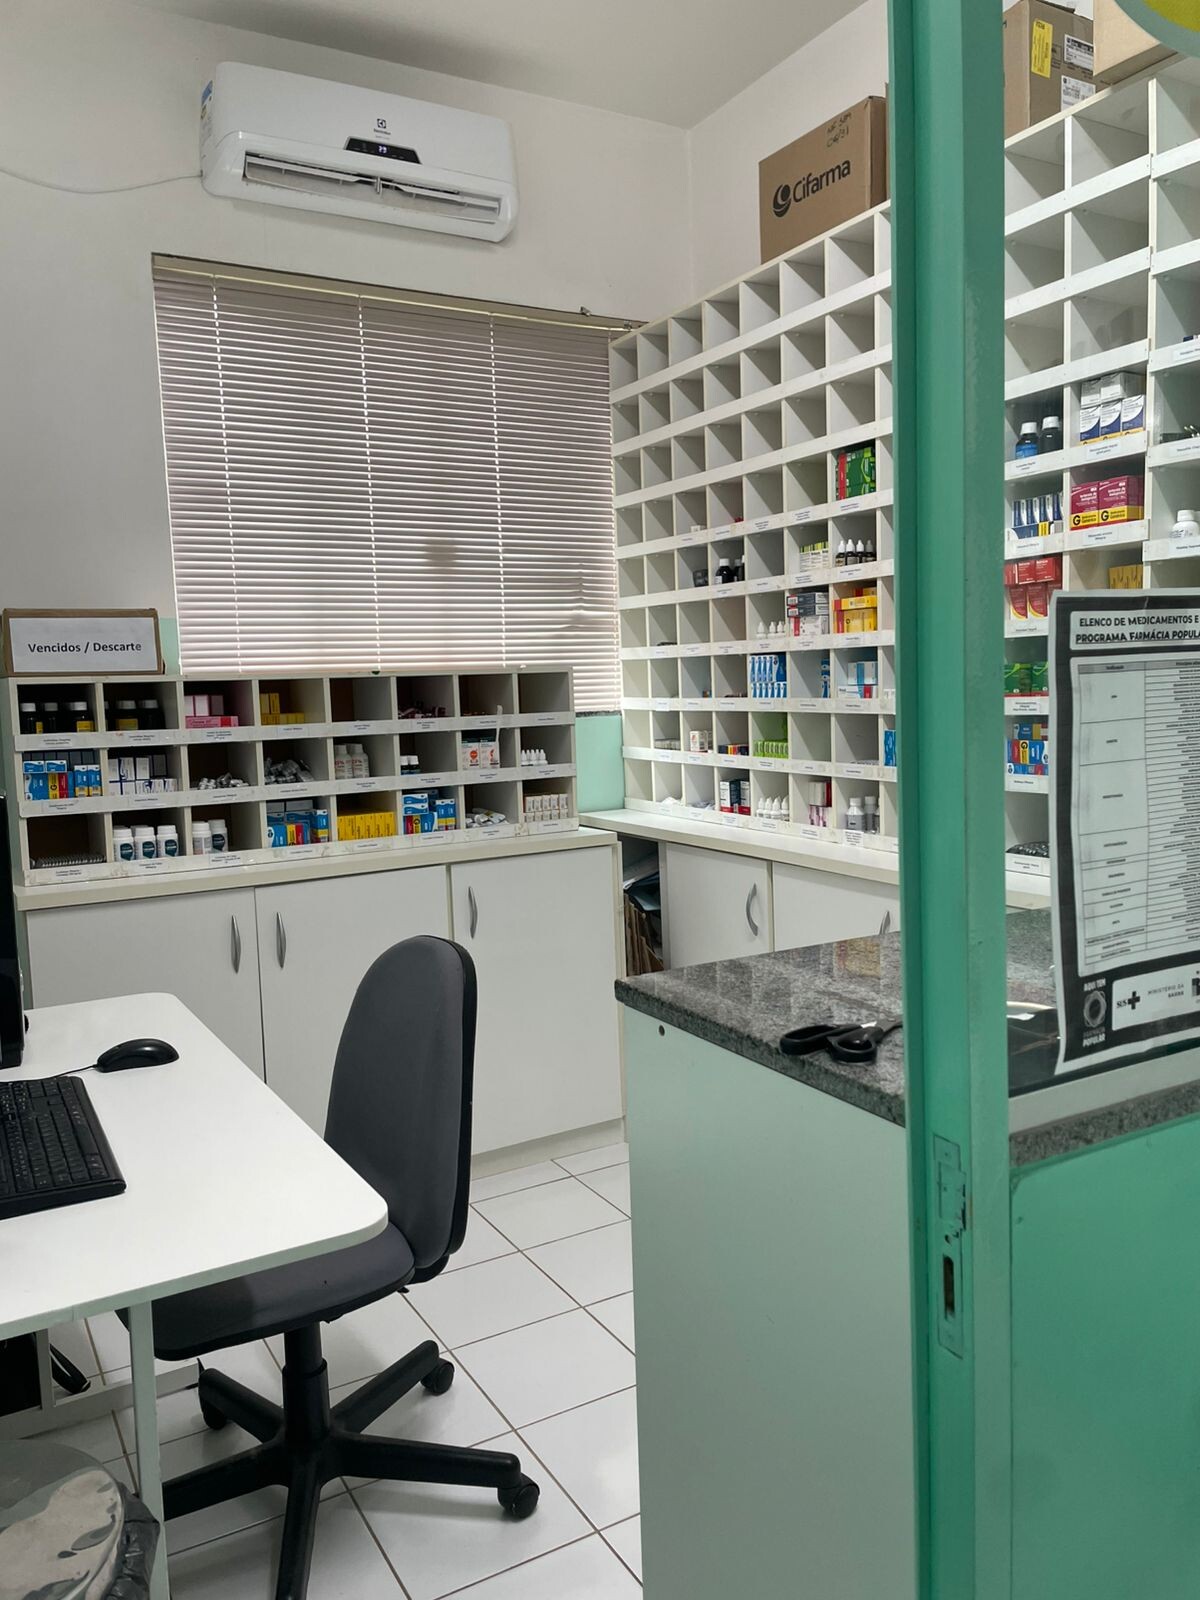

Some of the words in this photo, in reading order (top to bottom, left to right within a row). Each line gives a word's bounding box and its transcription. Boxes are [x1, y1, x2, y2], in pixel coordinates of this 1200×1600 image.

[792, 159, 851, 203] Cifarma
[1073, 515, 1081, 525] G
[1101, 510, 1109, 521] G
[1079, 617, 1112, 627] ELENCO
[1114, 617, 1126, 626] DE
[1128, 615, 1193, 626] MEDICAMENTOS
[1076, 633, 1127, 644] PROGRAMA
[1129, 629, 1170, 641] FARMÁCIA
[1172, 629, 1200, 640] POPUL
[28, 642, 81, 653] Vencidos
[84, 642, 90, 654] /
[93, 641, 142, 653] Descarte
